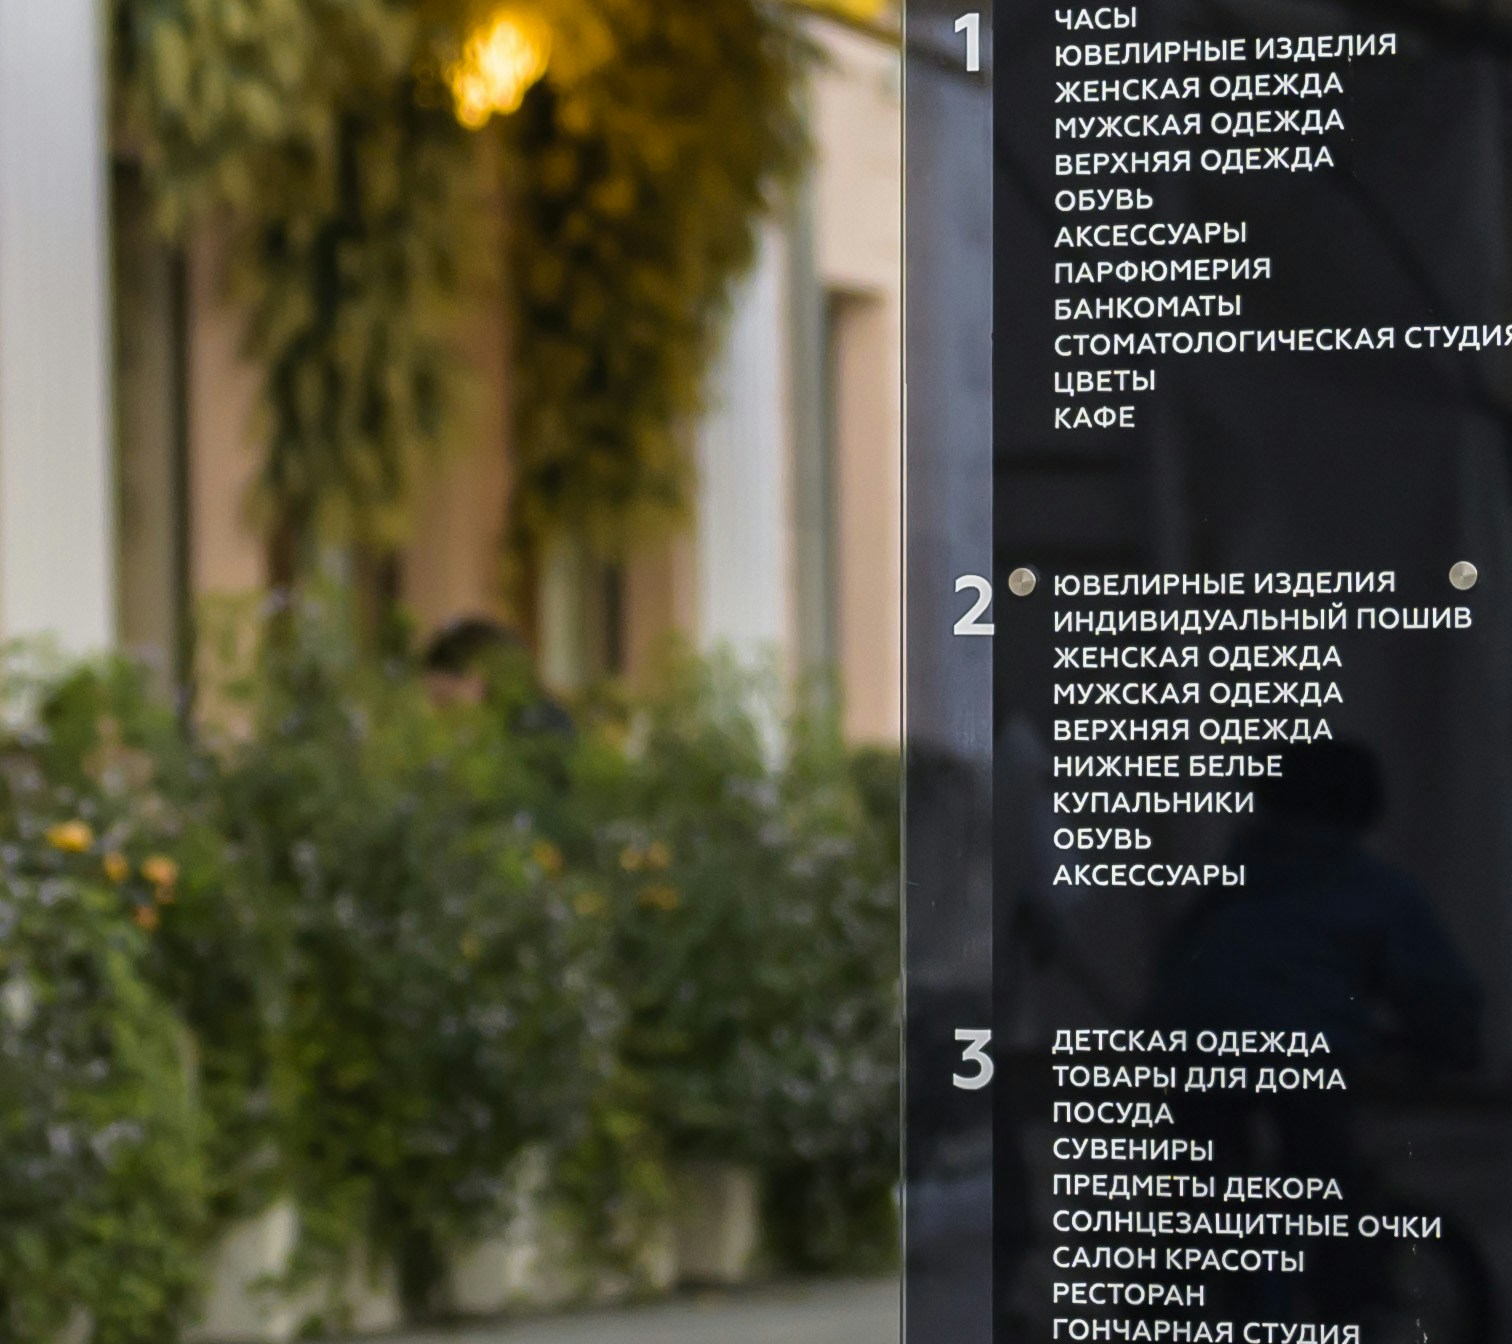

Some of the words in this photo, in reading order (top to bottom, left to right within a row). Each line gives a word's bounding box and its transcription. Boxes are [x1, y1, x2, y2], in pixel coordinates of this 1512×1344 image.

[1055, 7, 1136, 30] ЧАСЫ
[953, 12, 980, 72] 1
[1056, 39, 1246, 66] ЮВЕЛИРНЫЕ
[1256, 33, 1396, 62] ИЗДЕЛИЯ
[1055, 77, 1200, 103] ЖЕНСКАЯ
[1210, 72, 1343, 101] ОДЕЖДА
[1056, 113, 1201, 139] МУЖСКАЯ
[1211, 109, 1344, 137] ОДЕЖДА
[1056, 150, 1191, 175] ВЕРХНЯЯ
[1201, 146, 1334, 174] ОДЕЖДА
[1055, 188, 1153, 211] ОБУВЬ
[1054, 222, 1246, 247] АКСЕССУАРЫ
[1055, 258, 1270, 283] ПАРФЮМЕРИЯ
[1055, 295, 1241, 320] БАНКОМАТЫ
[1055, 327, 1394, 356] СТОМАТОЛОГИЧЕСКАЯ
[1055, 370, 1156, 397] ЦВЕТЫ
[1055, 406, 1135, 429] КАФЕ
[1054, 573, 1244, 596] ЮВЕЛИРНЫЕ
[1255, 571, 1395, 597] ИЗДЕЛИЯ
[953, 575, 995, 636] 2
[1054, 603, 1347, 636] ИНДИВИДУАЛЬНЫЙ
[1357, 607, 1472, 629] ПОШИВ
[1054, 646, 1198, 668] ЖЕНСКАЯ
[1209, 645, 1343, 671] ОДЕЖДА
[1054, 683, 1199, 704] МУЖСКАЯ
[1210, 682, 1344, 707] ОДЕЖДА
[1054, 719, 1189, 741] ВЕРХНЯЯ
[1200, 719, 1333, 744] ОДЕЖДА
[1054, 755, 1179, 777] НИЖНЕЕ
[1189, 755, 1282, 777] БЕЛЬЕ
[1054, 792, 1254, 813] КУПАЛЬНИКИ
[1054, 828, 1151, 849] ОБУВЬ
[1053, 864, 1245, 886] АКСЕССУАРЫ
[1052, 1029, 1187, 1055] ДЕТСКАЯ
[1197, 1031, 1330, 1057] ОДЕЖДА
[952, 1028, 994, 1089] 3
[1052, 1066, 1176, 1088] ТОВАРЫ
[1185, 1067, 1247, 1092] ДЛЯ
[1255, 1068, 1347, 1093] ДОМА
[1053, 1102, 1174, 1128] ПОСУДА
[1053, 1138, 1213, 1161] СУВЕНИРЫ
[1054, 1174, 1215, 1200] ПРЕДМЕТЫ
[1224, 1177, 1342, 1202] ДЕКОРА
[1053, 1210, 1349, 1238] СОЛНЦЕЗАЩИТНЫЕ
[1358, 1216, 1441, 1238] ОЧКИ
[1053, 1246, 1156, 1269] САЛОН
[1166, 1248, 1304, 1272] КРАСОТЫ
[1053, 1283, 1205, 1306] РЕСТОРАН
[1053, 1319, 1233, 1343] ГОНЧАРНАЯ
